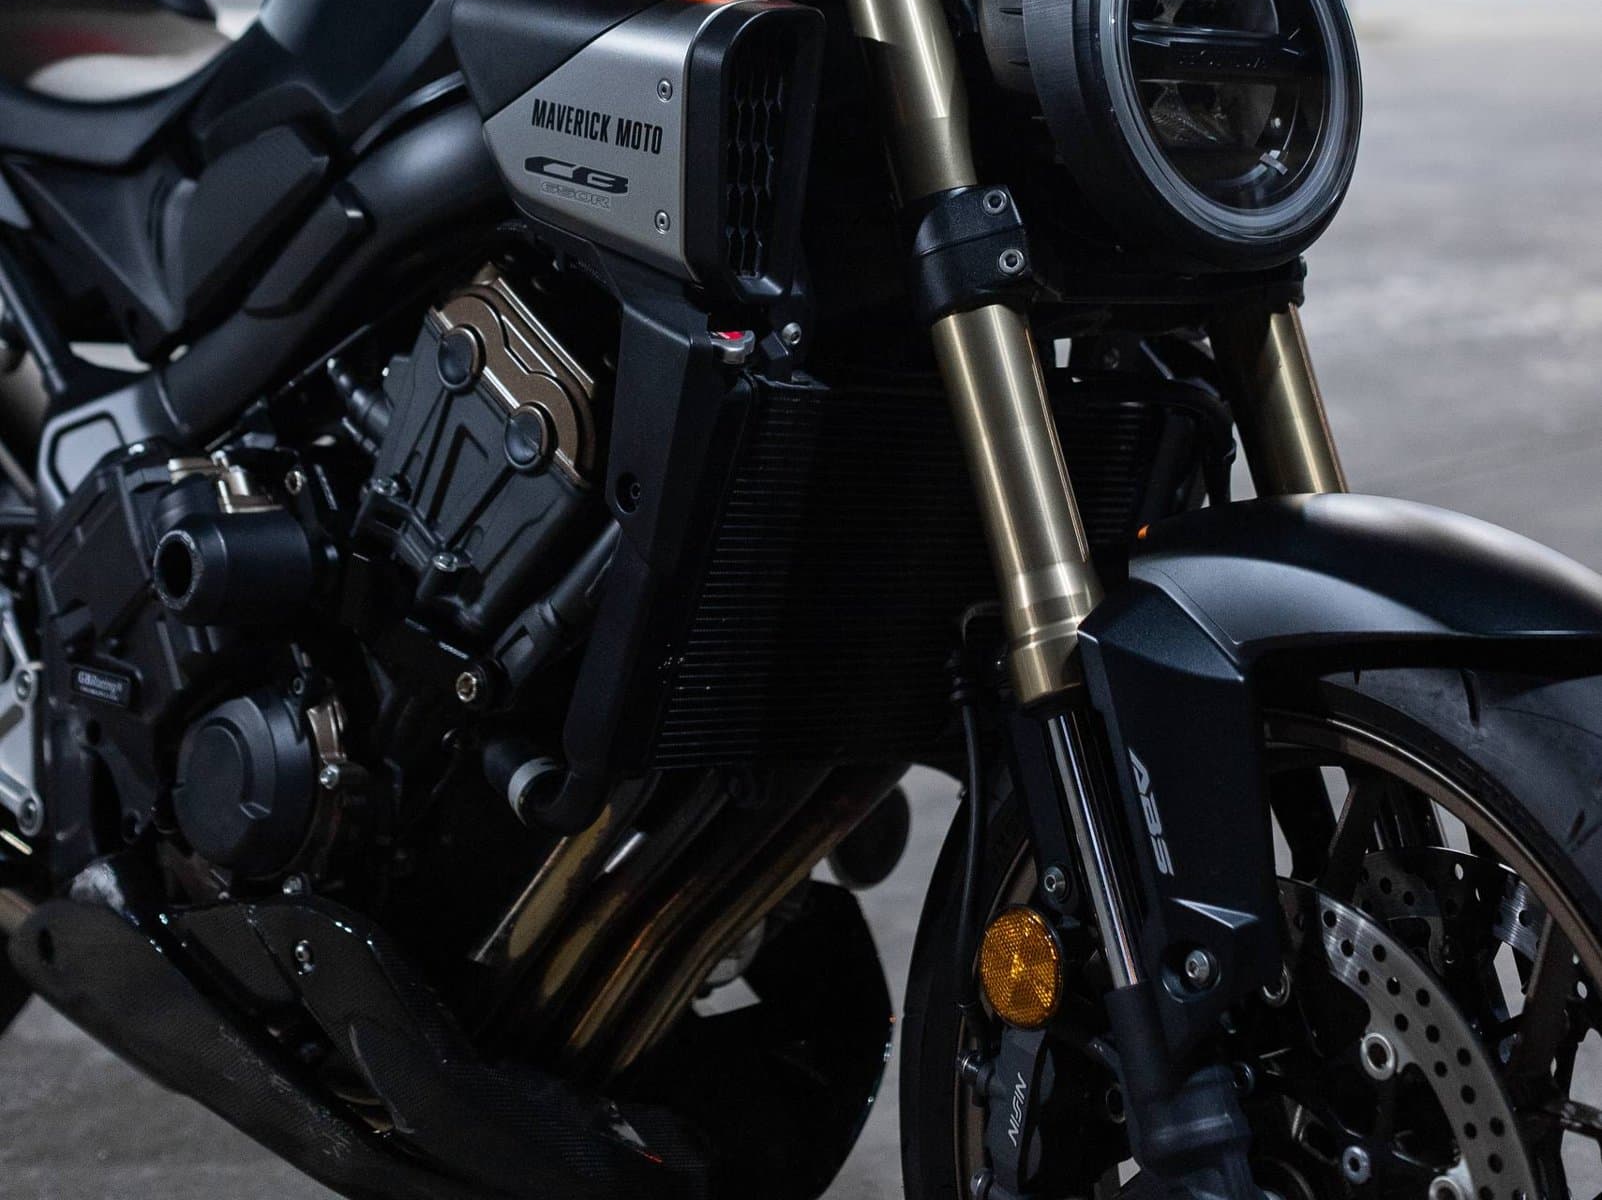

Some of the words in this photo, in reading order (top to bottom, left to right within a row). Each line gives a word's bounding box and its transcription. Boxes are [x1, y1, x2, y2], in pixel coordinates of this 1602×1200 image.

[532, 98, 611, 143] MAVERICK
[615, 118, 663, 155] MOTO
[525, 156, 628, 194] CB
[1129, 747, 1174, 877] ABS
